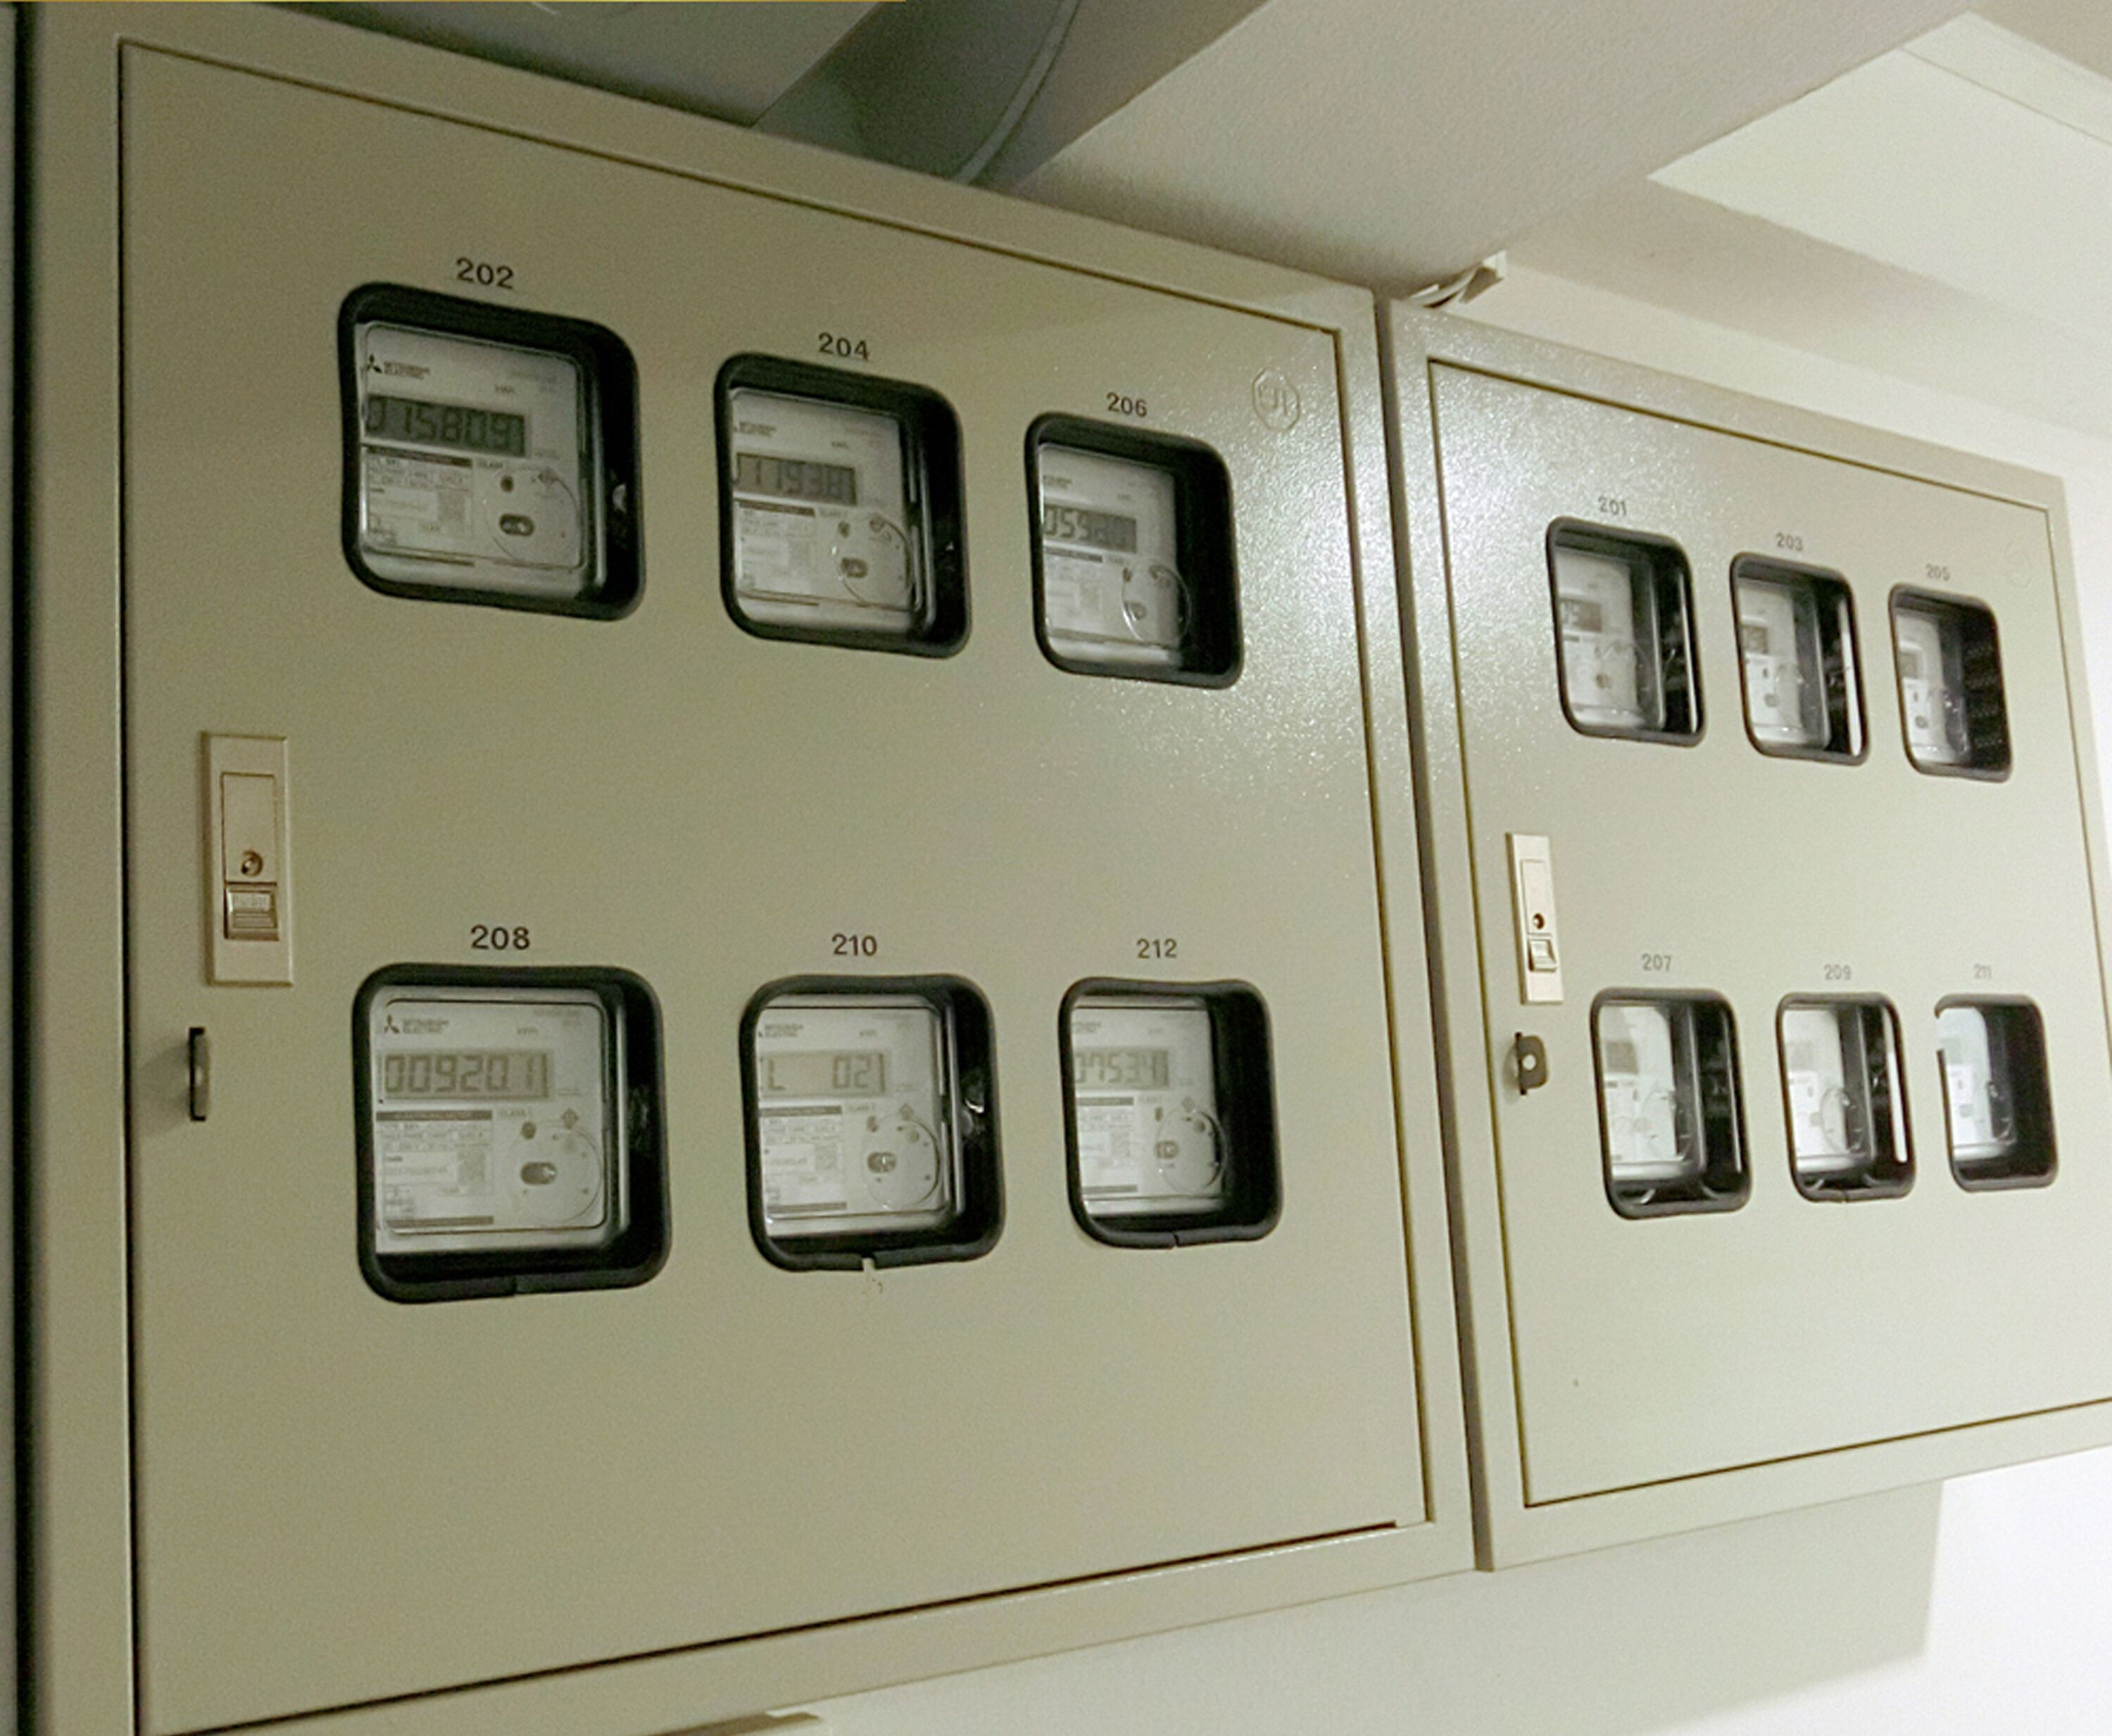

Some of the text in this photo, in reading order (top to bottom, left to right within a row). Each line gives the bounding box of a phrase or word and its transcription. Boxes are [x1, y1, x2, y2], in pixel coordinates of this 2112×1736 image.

[456, 256, 515, 289] 202
[818, 332, 870, 362] 204
[1106, 392, 1148, 418] 206
[1598, 496, 1628, 517] 201
[1775, 532, 1804, 553] 203
[1925, 562, 1951, 582] 205
[470, 924, 531, 951] 208
[831, 932, 878, 957] 210
[1136, 937, 1178, 960] 212
[1641, 952, 1673, 973] 207
[1823, 963, 1852, 981] 209
[1973, 962, 1992, 980] 211
